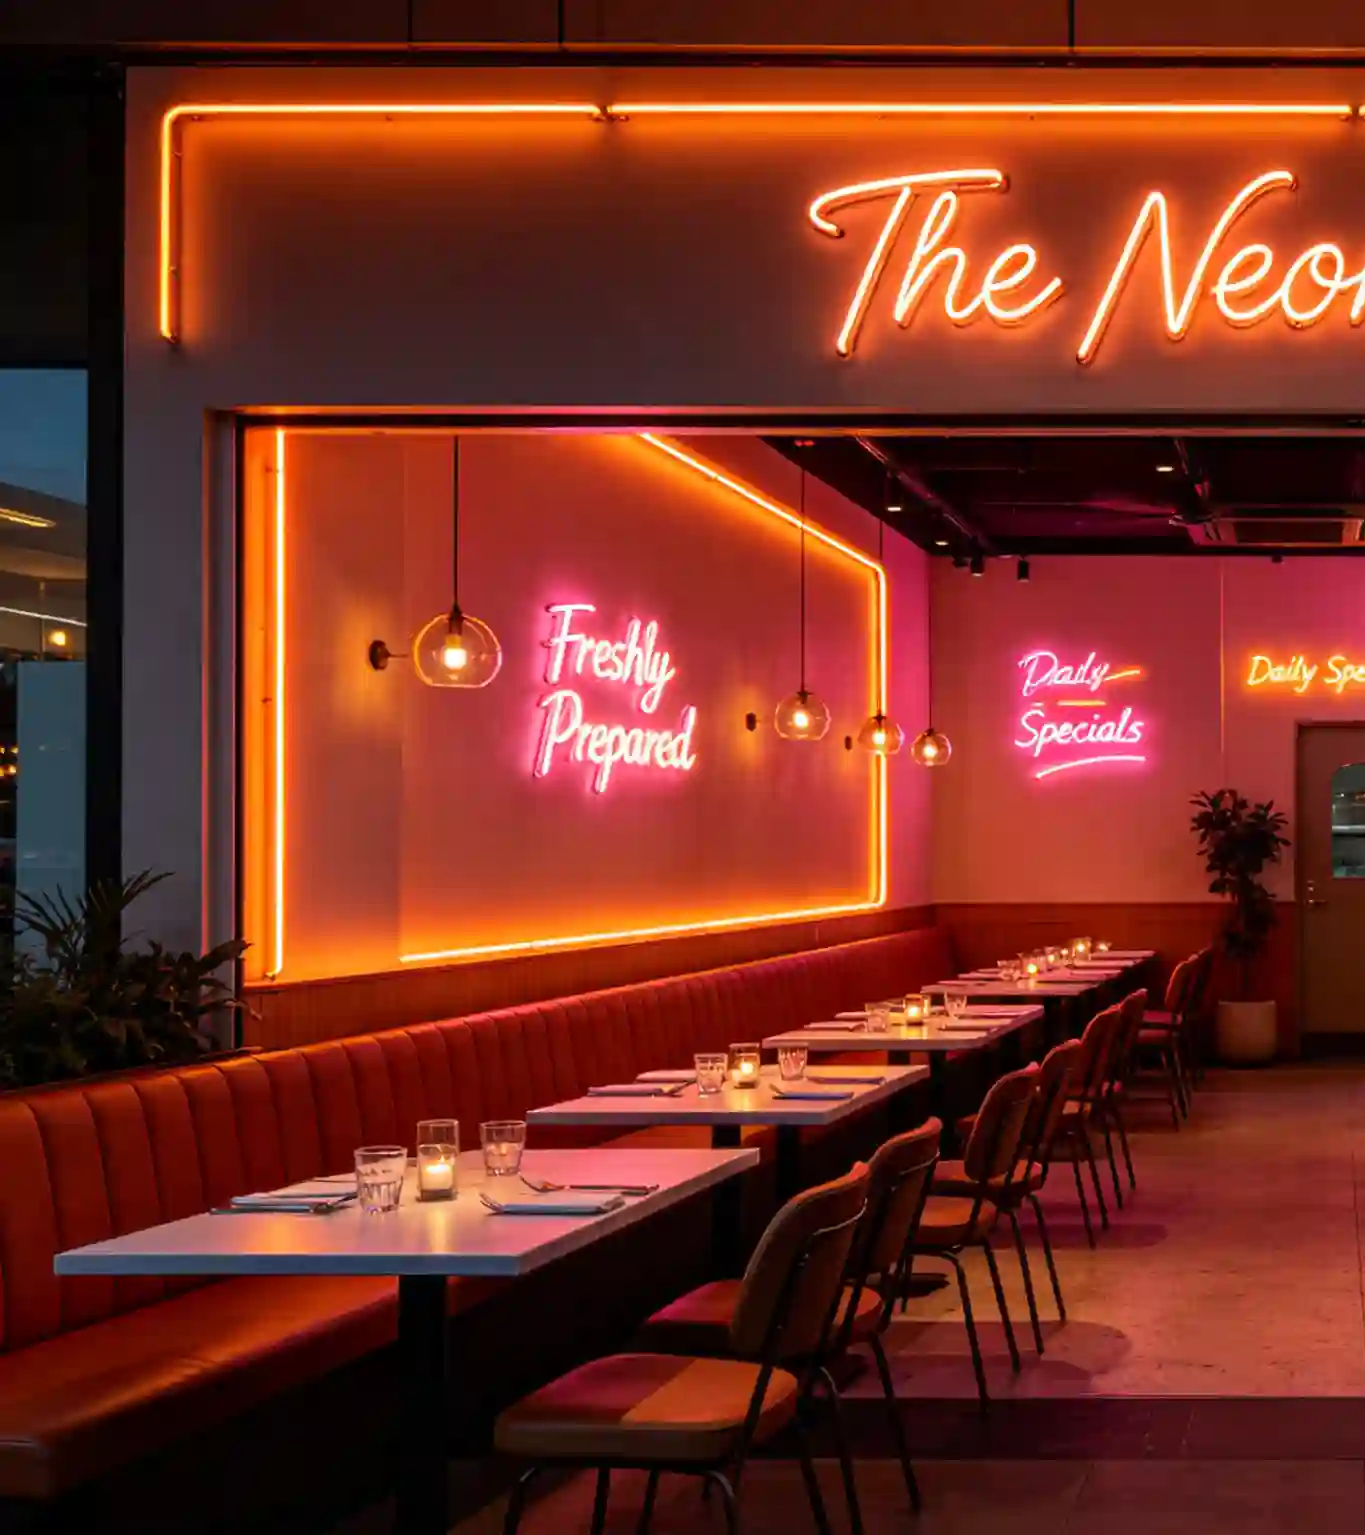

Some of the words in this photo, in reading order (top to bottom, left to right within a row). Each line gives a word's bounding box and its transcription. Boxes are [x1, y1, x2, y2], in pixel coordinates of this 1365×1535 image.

[810, 168, 1062, 357] The
[547, 603, 676, 713] Freshly
[1018, 651, 1111, 697] Daily
[1246, 655, 1319, 693] Daily
[534, 689, 697, 794] Prepared
[1014, 707, 1145, 757] Specials
